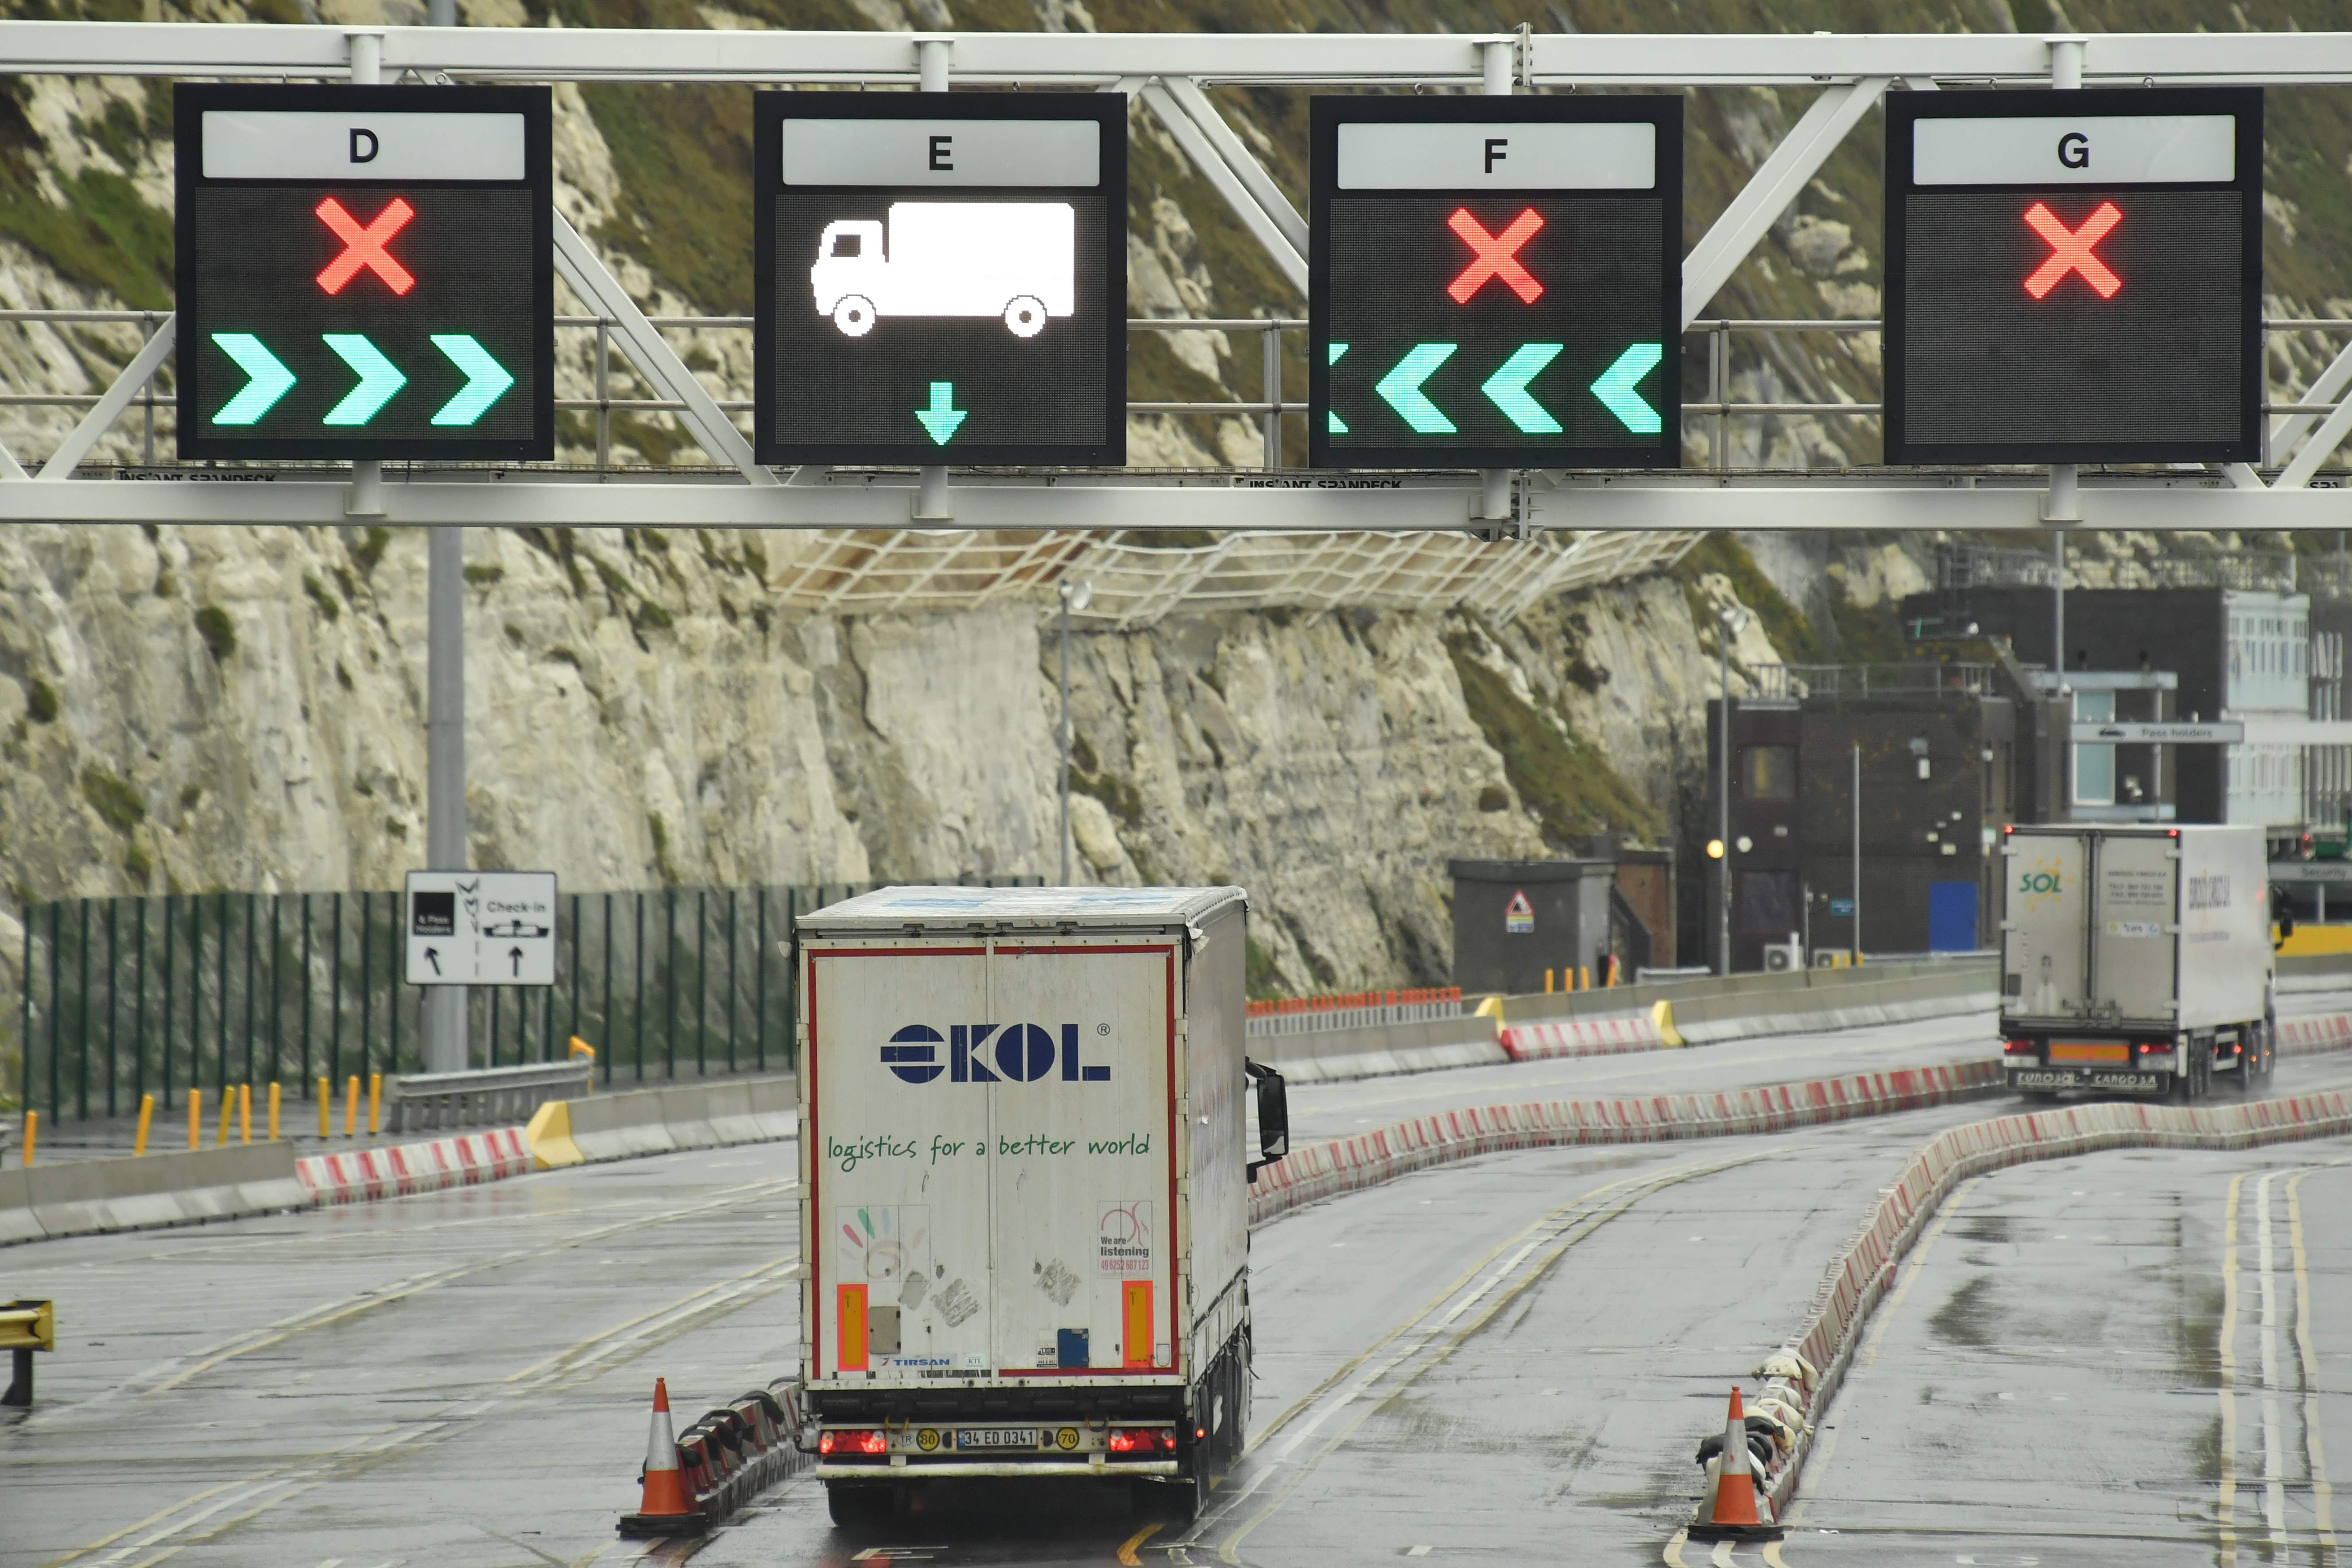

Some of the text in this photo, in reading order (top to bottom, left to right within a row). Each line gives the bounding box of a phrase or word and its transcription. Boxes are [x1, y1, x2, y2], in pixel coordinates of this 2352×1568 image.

[350, 128, 379, 163] D
[2058, 132, 2090, 168] G
[929, 136, 953, 170] E
[1484, 139, 1508, 174] F
[2019, 873, 2062, 893] SOL
[486, 901, 546, 913] Check-in
[418, 914, 449, 924] & Pass
[2095, 1074, 2138, 1085] CARGO
[828, 1133, 1150, 1173] logistics for a better world
[1100, 1236, 1112, 1245] We
[1100, 1247, 1149, 1258] listening
[1101, 1260, 1108, 1270] 49
[921, 1434, 936, 1444] 80
[965, 1432, 980, 1444] 34
[984, 1431, 999, 1444] ED
[1004, 1431, 1033, 1444] 0341
[1060, 1433, 1077, 1444] 70
